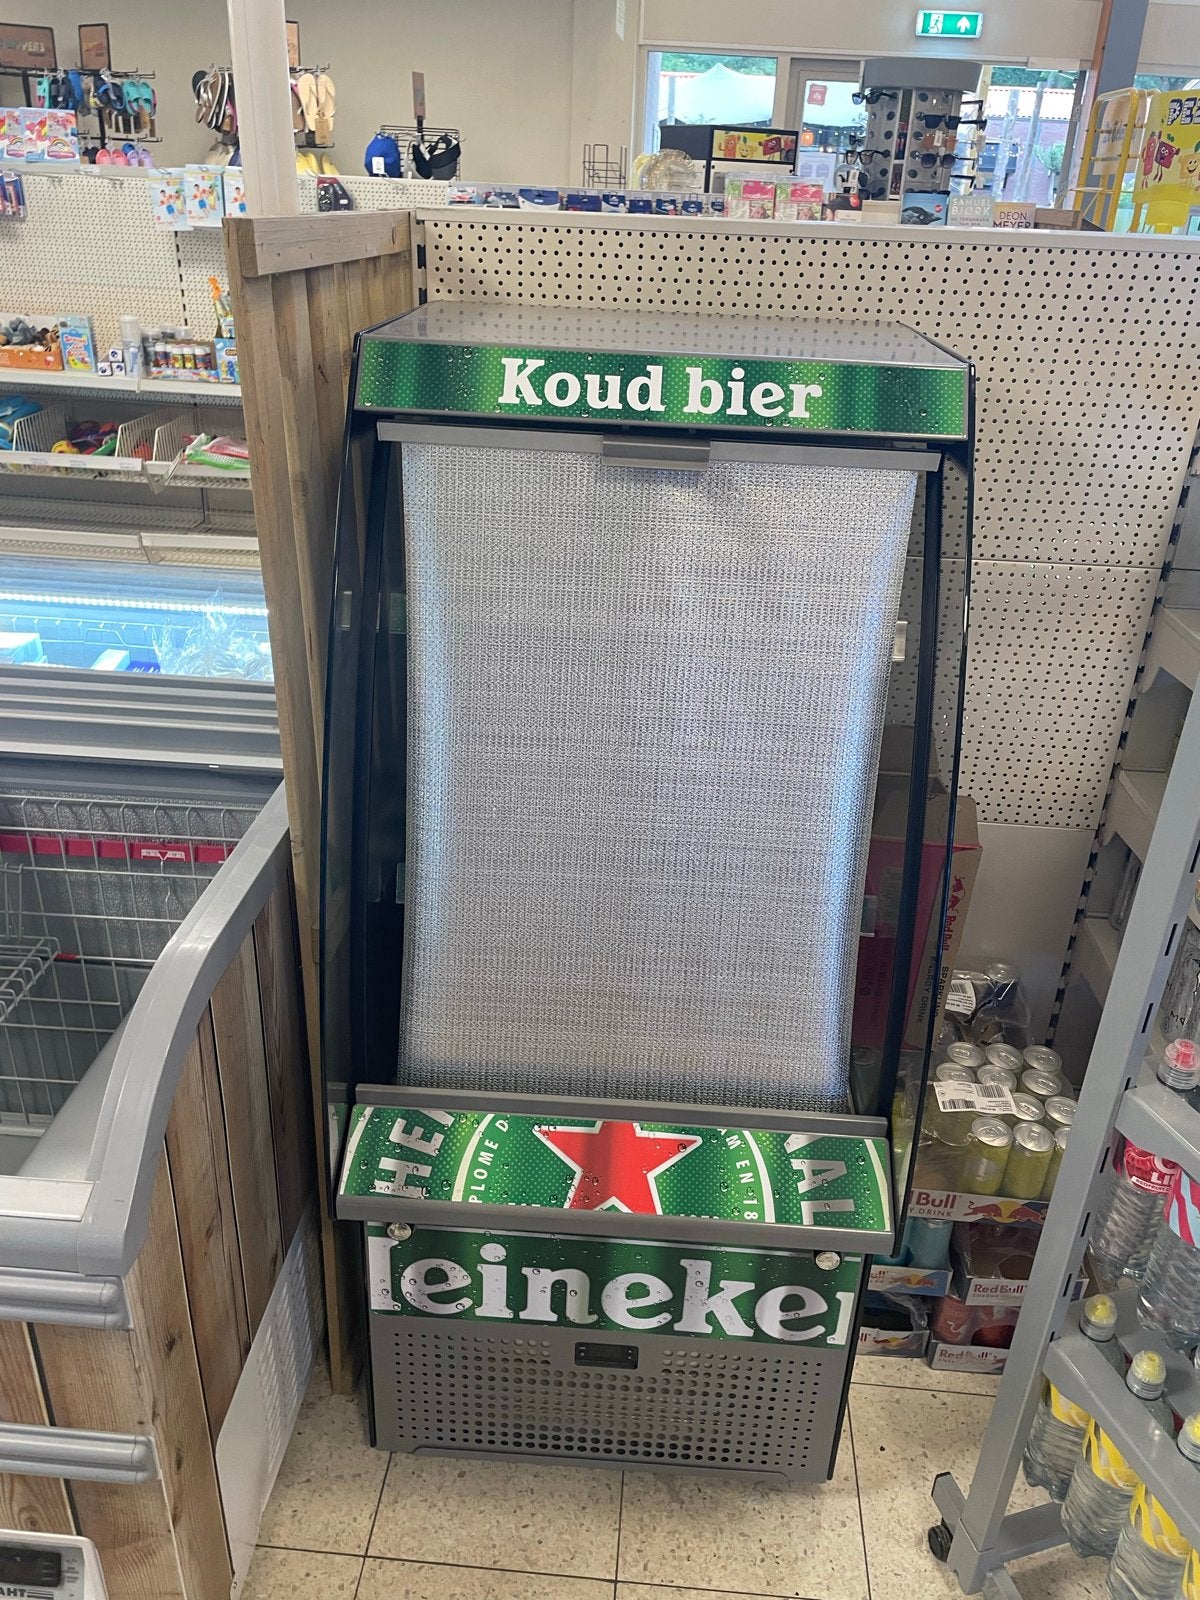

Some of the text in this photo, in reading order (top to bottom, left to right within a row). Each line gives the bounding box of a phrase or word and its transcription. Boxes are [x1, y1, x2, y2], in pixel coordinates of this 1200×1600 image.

[953, 199, 992, 207] SAMUEL
[1000, 211, 1028, 221] DEON
[498, 357, 823, 418] Koud bier
[917, 996, 931, 1024] DRINK
[736, 1159, 755, 1184] EN
[916, 1191, 957, 1209] Bull
[918, 1208, 953, 1218] DRINK
[974, 1283, 1024, 1294] Red Bull
[940, 1349, 964, 1359] Red
